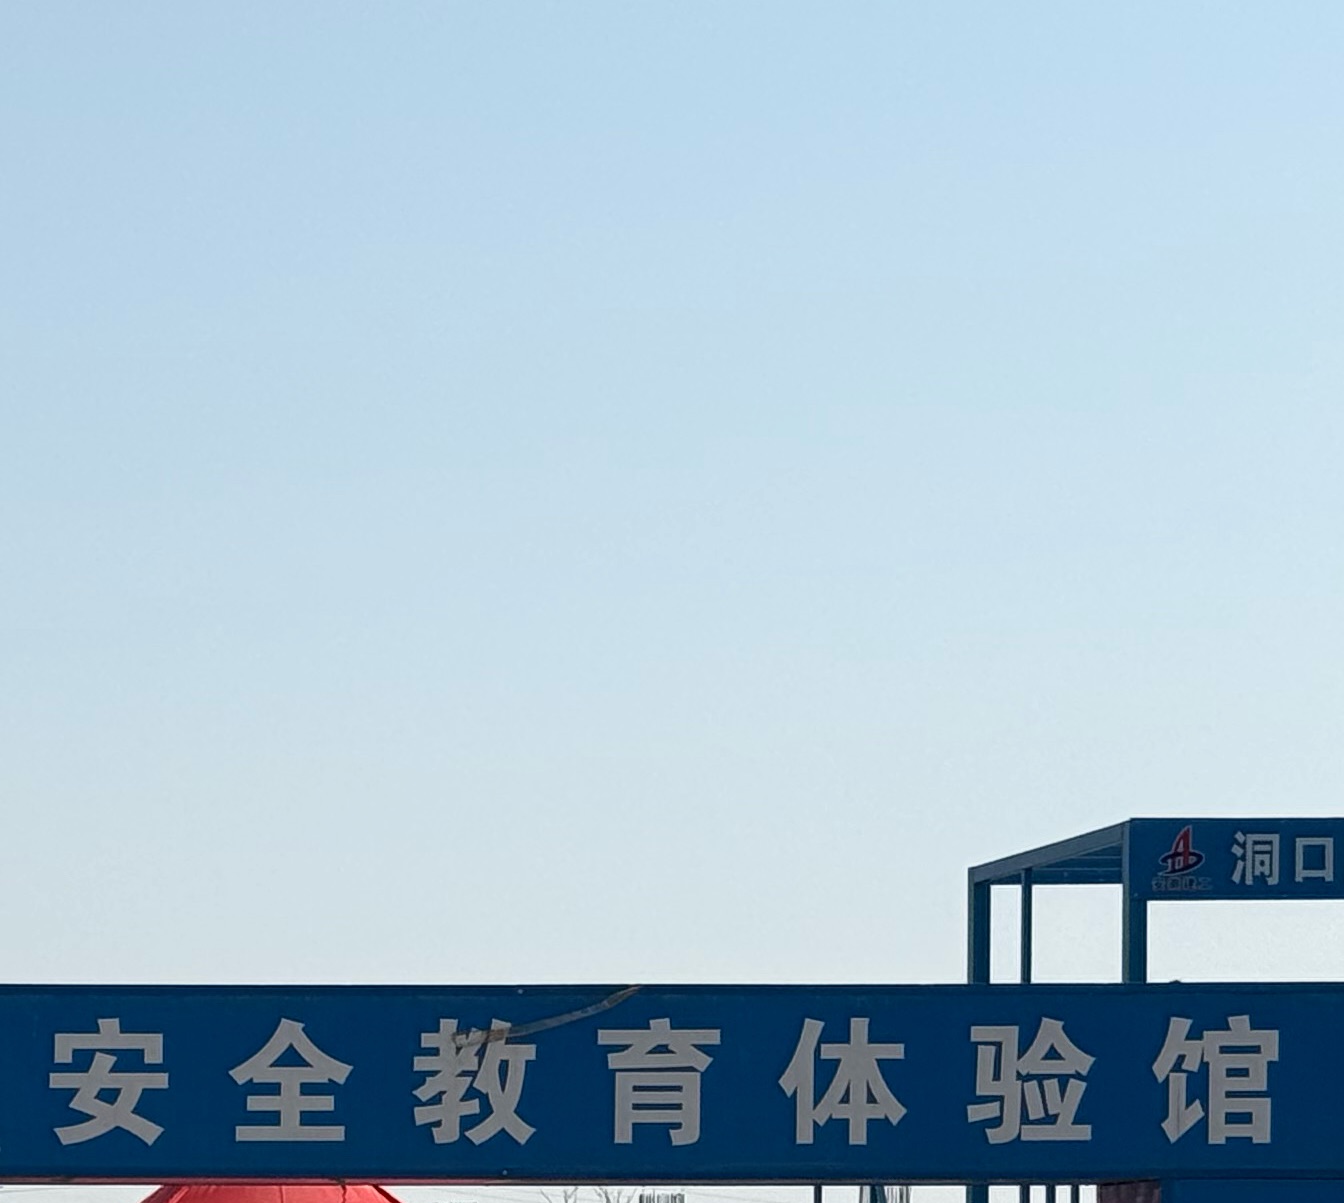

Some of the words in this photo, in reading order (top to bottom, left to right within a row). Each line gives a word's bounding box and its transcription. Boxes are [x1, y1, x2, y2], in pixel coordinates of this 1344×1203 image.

[1231, 831, 1335, 887] 洞口
[49, 1015, 1280, 1146] 安全教育体验馆
